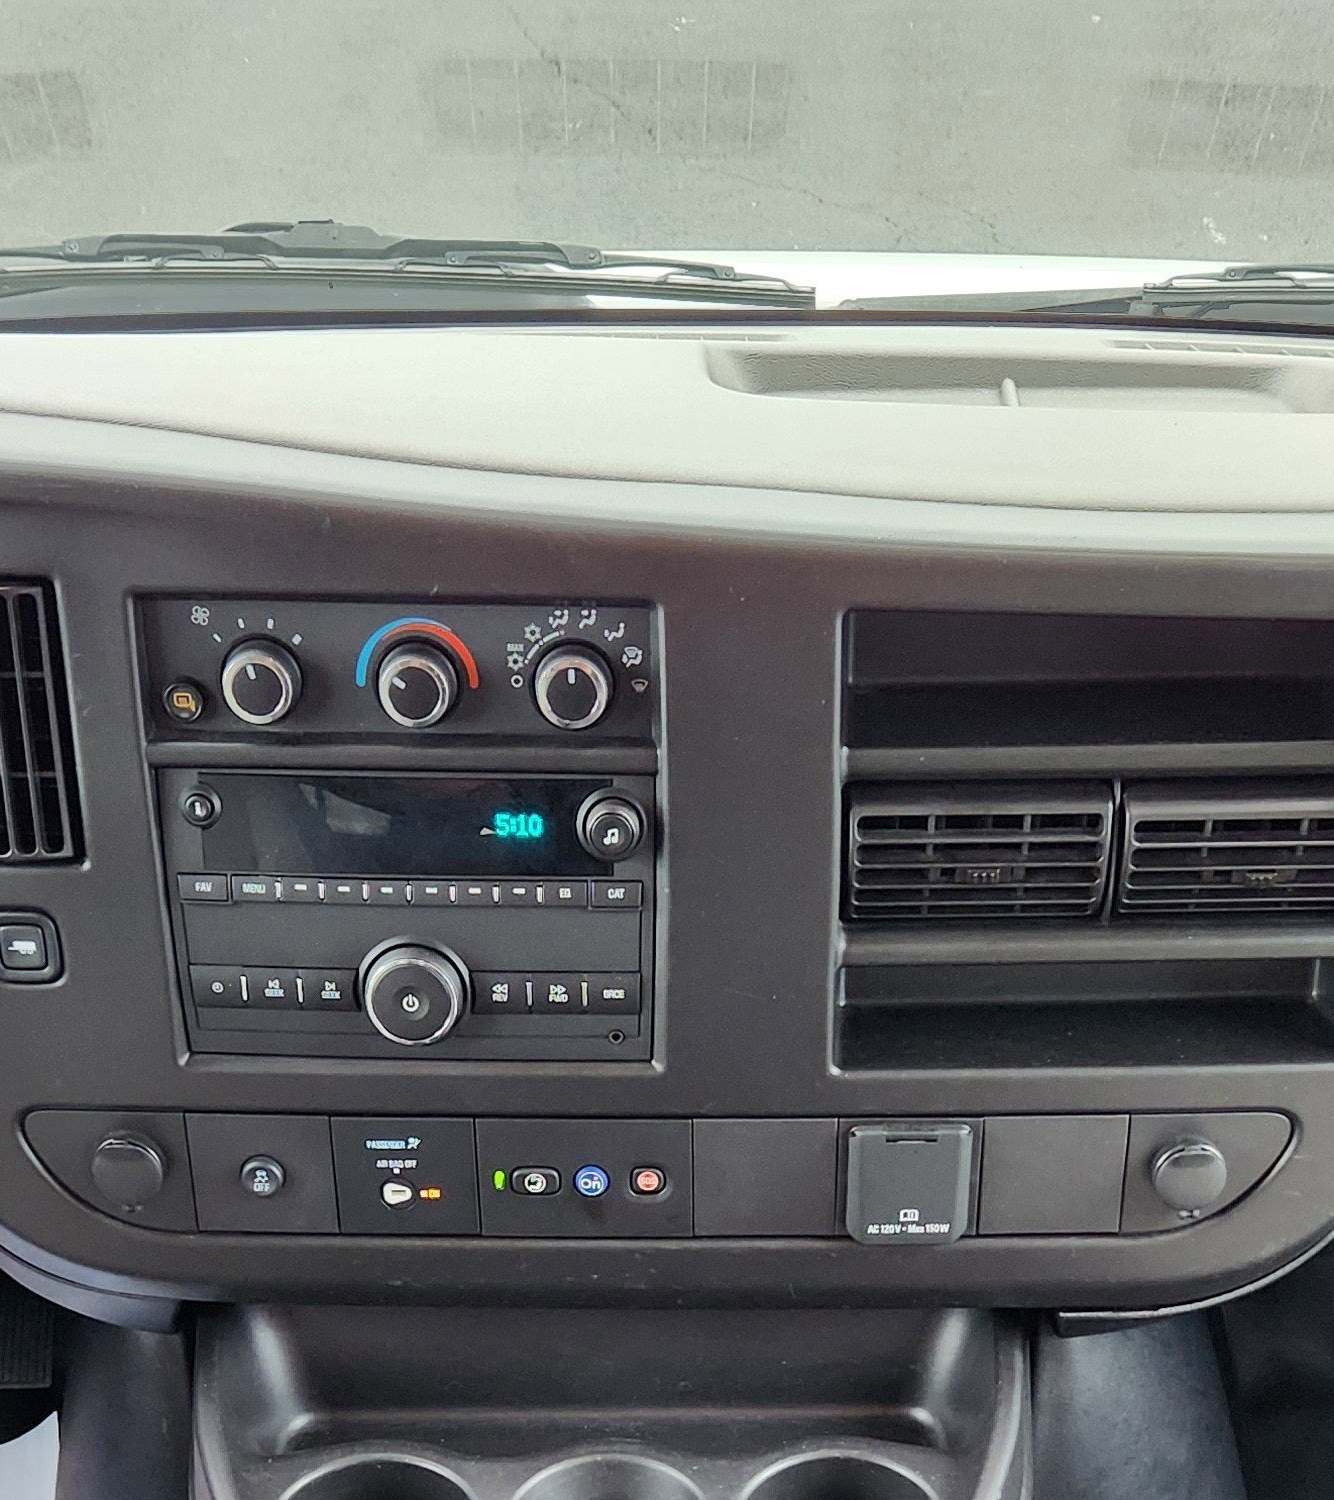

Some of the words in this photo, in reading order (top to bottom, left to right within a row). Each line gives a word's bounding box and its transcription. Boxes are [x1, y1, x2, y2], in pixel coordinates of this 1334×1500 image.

[494, 812, 543, 838] 5:10
[194, 881, 212, 892] FAV
[241, 882, 266, 894] MENU
[607, 887, 626, 900] CAT
[365, 1140, 406, 1150] PASSENGER
[376, 1159, 388, 1168] AIR
[405, 1159, 418, 1169] OFF
[253, 1182, 270, 1192] OFF
[867, 1224, 880, 1234] AC
